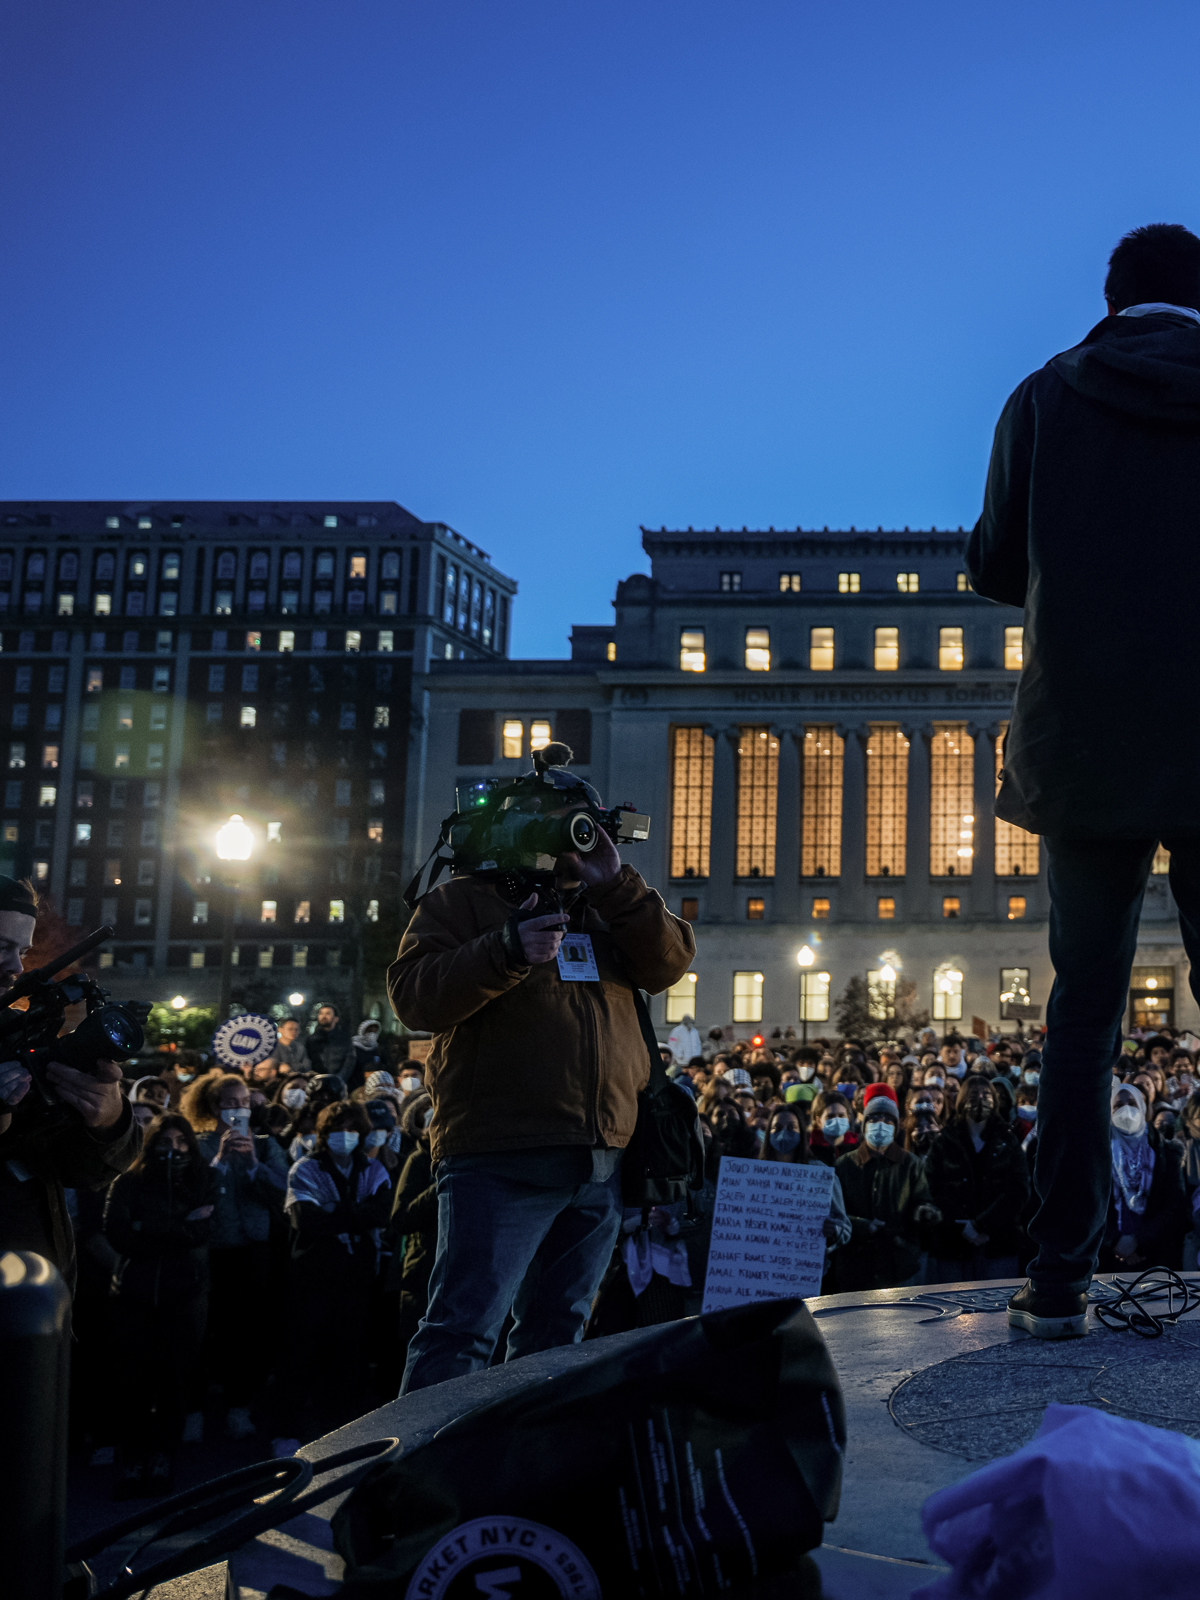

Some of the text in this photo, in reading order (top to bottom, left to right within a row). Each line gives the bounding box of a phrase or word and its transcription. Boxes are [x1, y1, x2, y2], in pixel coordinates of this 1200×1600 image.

[734, 689, 801, 702] HOMER
[814, 689, 930, 702] HERODOTUS
[231, 1033, 261, 1051] UAW
[725, 1160, 749, 1174] JOUD
[753, 1163, 779, 1176] HAMID
[781, 1167, 809, 1180] NASSER
[746, 1178, 771, 1189] YAHYA
[719, 1190, 745, 1201] SALEH
[750, 1192, 767, 1203] ALI
[770, 1194, 794, 1206] SALEH
[717, 1203, 743, 1213] FATIMA
[746, 1206, 774, 1217] KHALIL
[714, 1217, 741, 1228] MARIA
[744, 1218, 769, 1230] YASSER
[770, 1222, 793, 1234] KAMAL
[712, 1230, 820, 1251] SANAA ADNAN AL-KURD
[710, 1250, 742, 1262] RAHAF
[744, 1252, 767, 1263] RAMI
[708, 1267, 734, 1278] AMAL
[772, 1271, 798, 1282] KHALED
[706, 1285, 732, 1295] MIRNA
[735, 1286, 751, 1297] ALI
[418, 1534, 468, 1600] RKET
[481, 1526, 537, 1547] NYC
